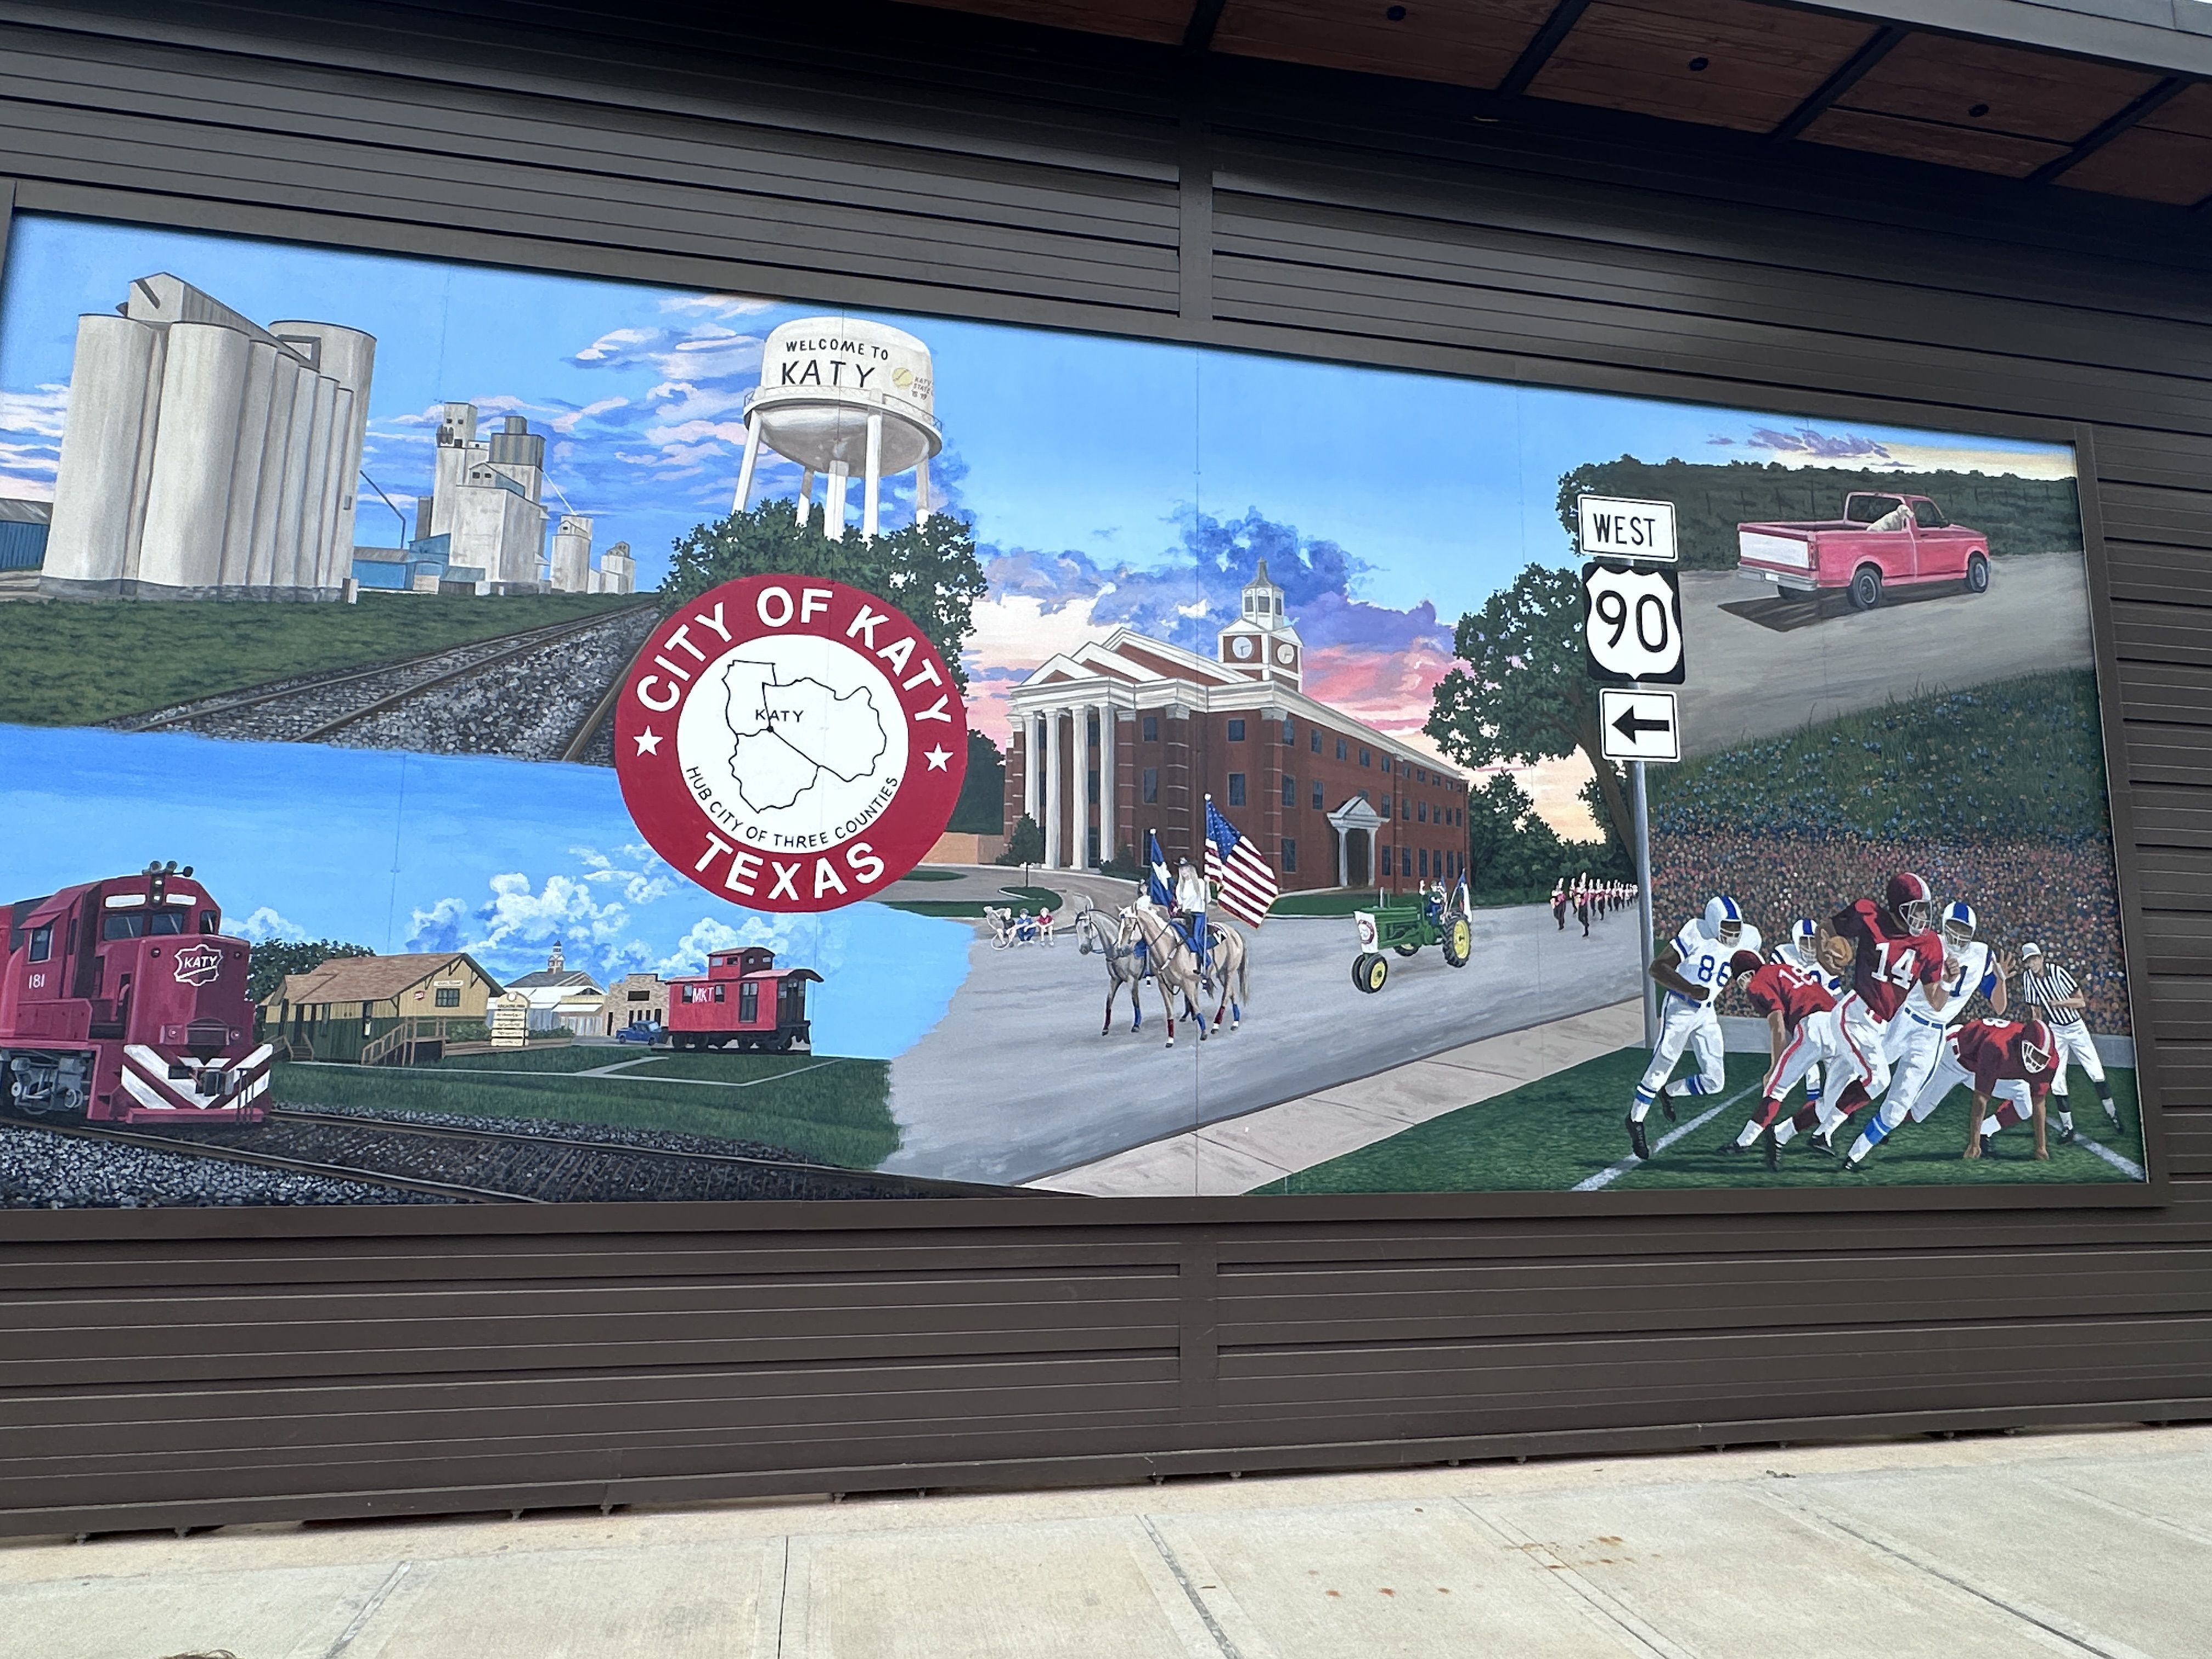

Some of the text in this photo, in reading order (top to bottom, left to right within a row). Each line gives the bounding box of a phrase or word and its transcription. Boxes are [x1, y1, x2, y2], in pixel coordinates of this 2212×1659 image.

[786, 338, 889, 361] WELCOME TO
[781, 359, 876, 388] KATY
[1593, 513, 1656, 548] WEST
[1596, 589, 1668, 653] 90
[636, 586, 952, 724] CITY OF KATY
[755, 709, 804, 723] KATY
[685, 766, 899, 849] HUB CITY OF THREE COUNTIES
[693, 831, 885, 901] TEXAS
[184, 956, 218, 969] KATY
[1871, 941, 1916, 990] 14
[29, 973, 45, 989] 181
[692, 987, 714, 1003] MKT
